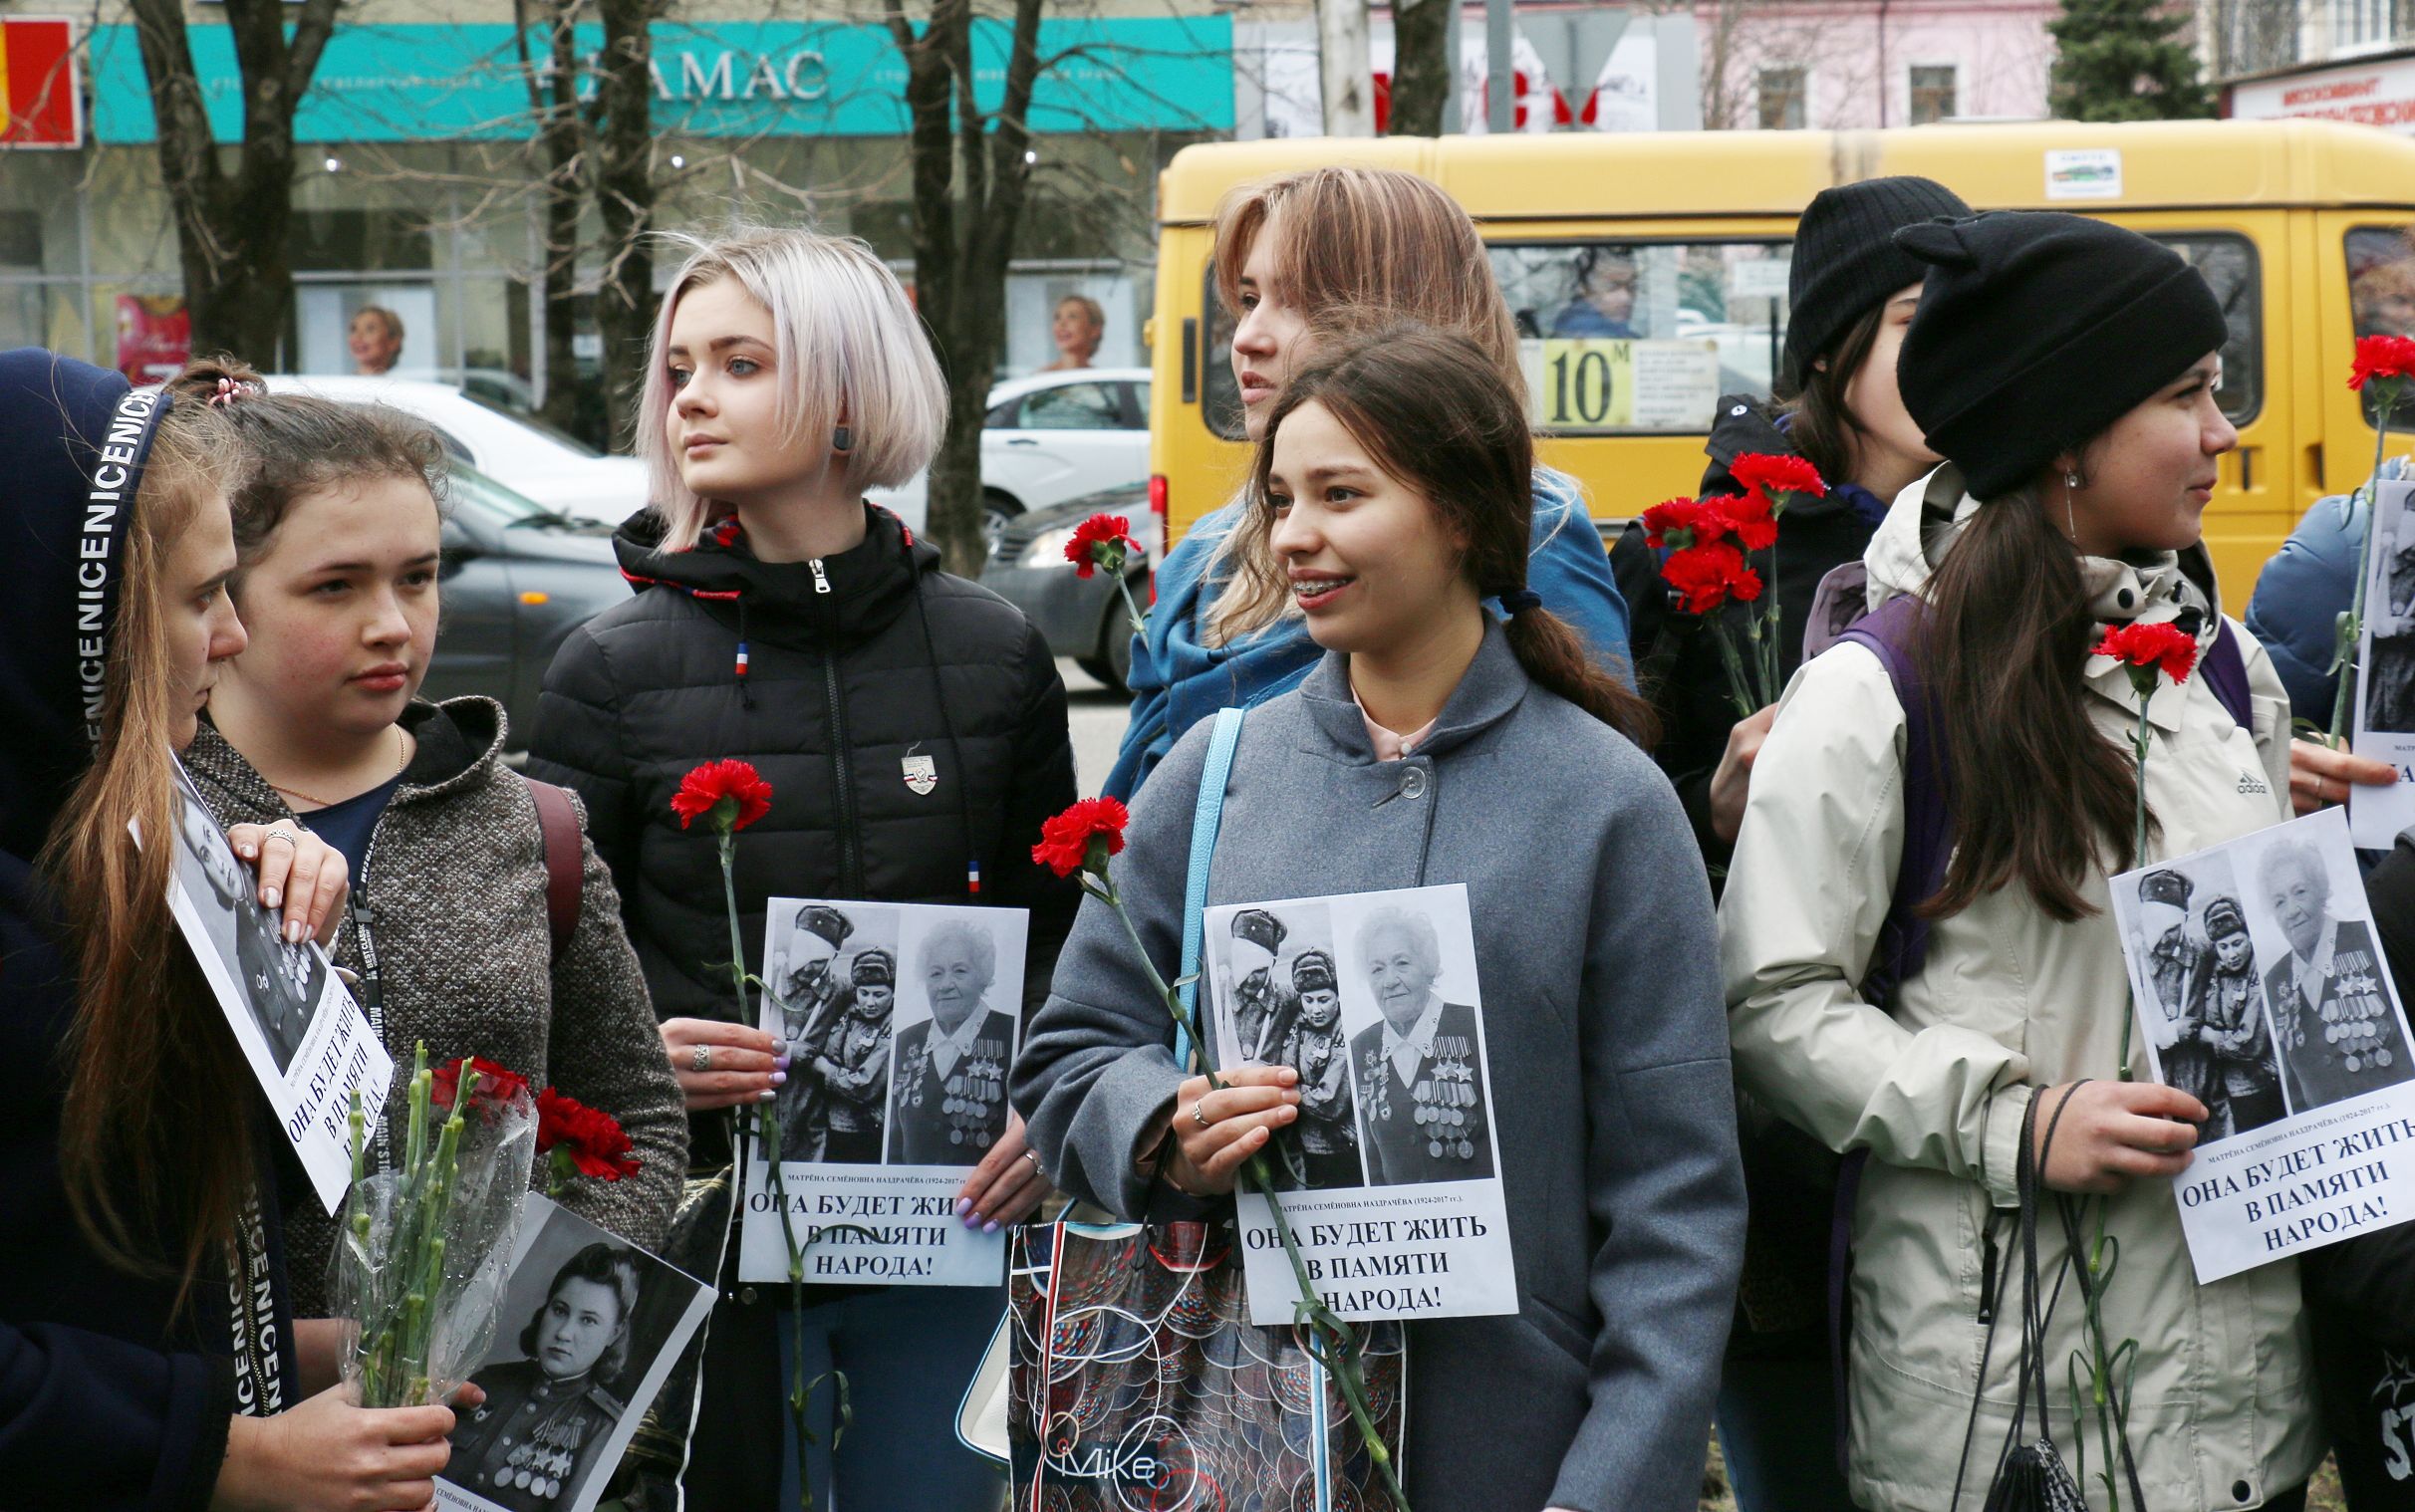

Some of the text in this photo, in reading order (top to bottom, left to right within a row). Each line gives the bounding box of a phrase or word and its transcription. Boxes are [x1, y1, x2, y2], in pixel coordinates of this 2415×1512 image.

[1551, 352, 1612, 422] 10
[363, 950, 375, 969] BEST
[289, 1098, 317, 1143] ОНА
[310, 1036, 344, 1104] БУДЕТ
[334, 995, 356, 1048] ЖИТЬ
[324, 1116, 337, 1140] В
[343, 1079, 385, 1162] НОДА!
[2183, 1176, 2242, 1208] ОНА
[2244, 1143, 2327, 1188] БУДЕТ
[1313, 1200, 1362, 1211] СЕМЁНОВНА
[2245, 1160, 2391, 1223] В ПАМЯТИ
[750, 1193, 808, 1213] ОНА
[818, 1195, 905, 1219] БУДЕТ
[807, 1225, 947, 1246] В ПАМЯТИ
[1246, 1215, 1487, 1250] ОНА БУДЕТ ЖИТЬ
[2264, 1195, 2389, 1251] НАРОДА!
[814, 1256, 933, 1279] НАРОДА!
[1306, 1252, 1451, 1280] В ПАМЯТИ
[1322, 1286, 1443, 1313] НАРОДА!
